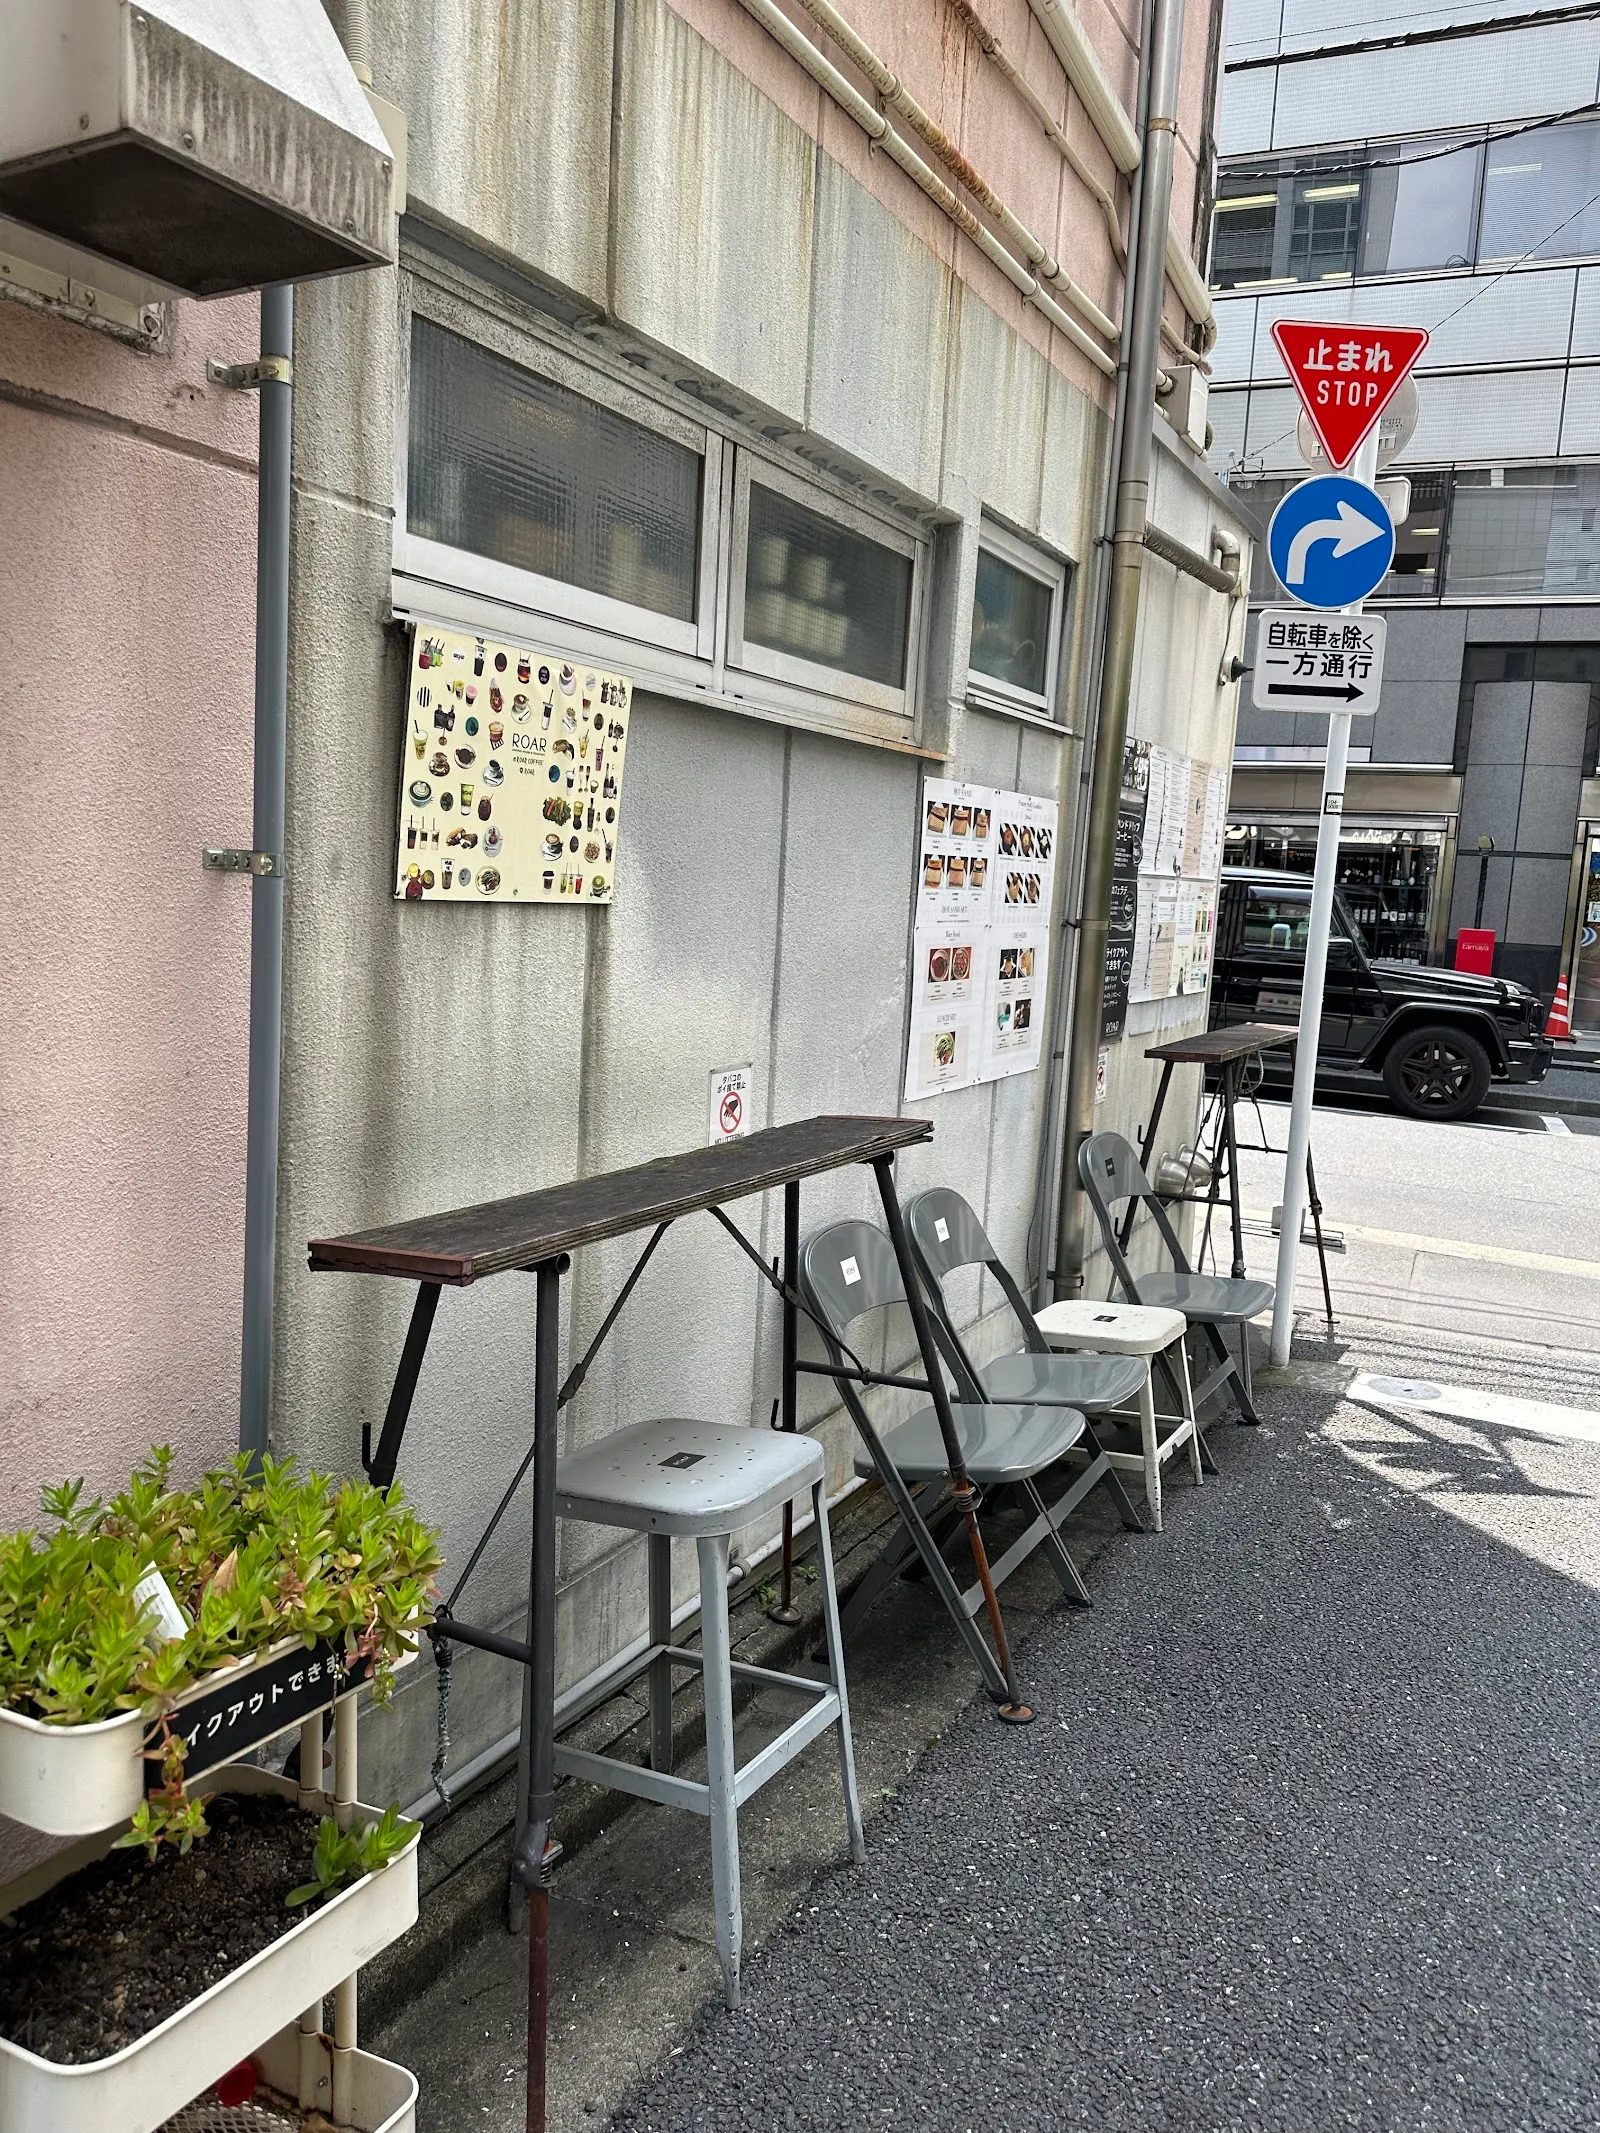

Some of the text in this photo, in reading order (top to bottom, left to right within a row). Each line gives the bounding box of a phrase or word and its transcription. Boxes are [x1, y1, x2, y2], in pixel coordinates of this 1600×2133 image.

[1302, 338, 1394, 374] 止まれ
[1316, 379, 1378, 407] STOP
[1268, 621, 1374, 651] 自転車を除く
[1265, 651, 1373, 679] 一方通行
[511, 732, 547, 753] ROAR
[1462, 942, 1490, 952] tamaya
[187, 1652, 341, 1747] イクアウトできま
